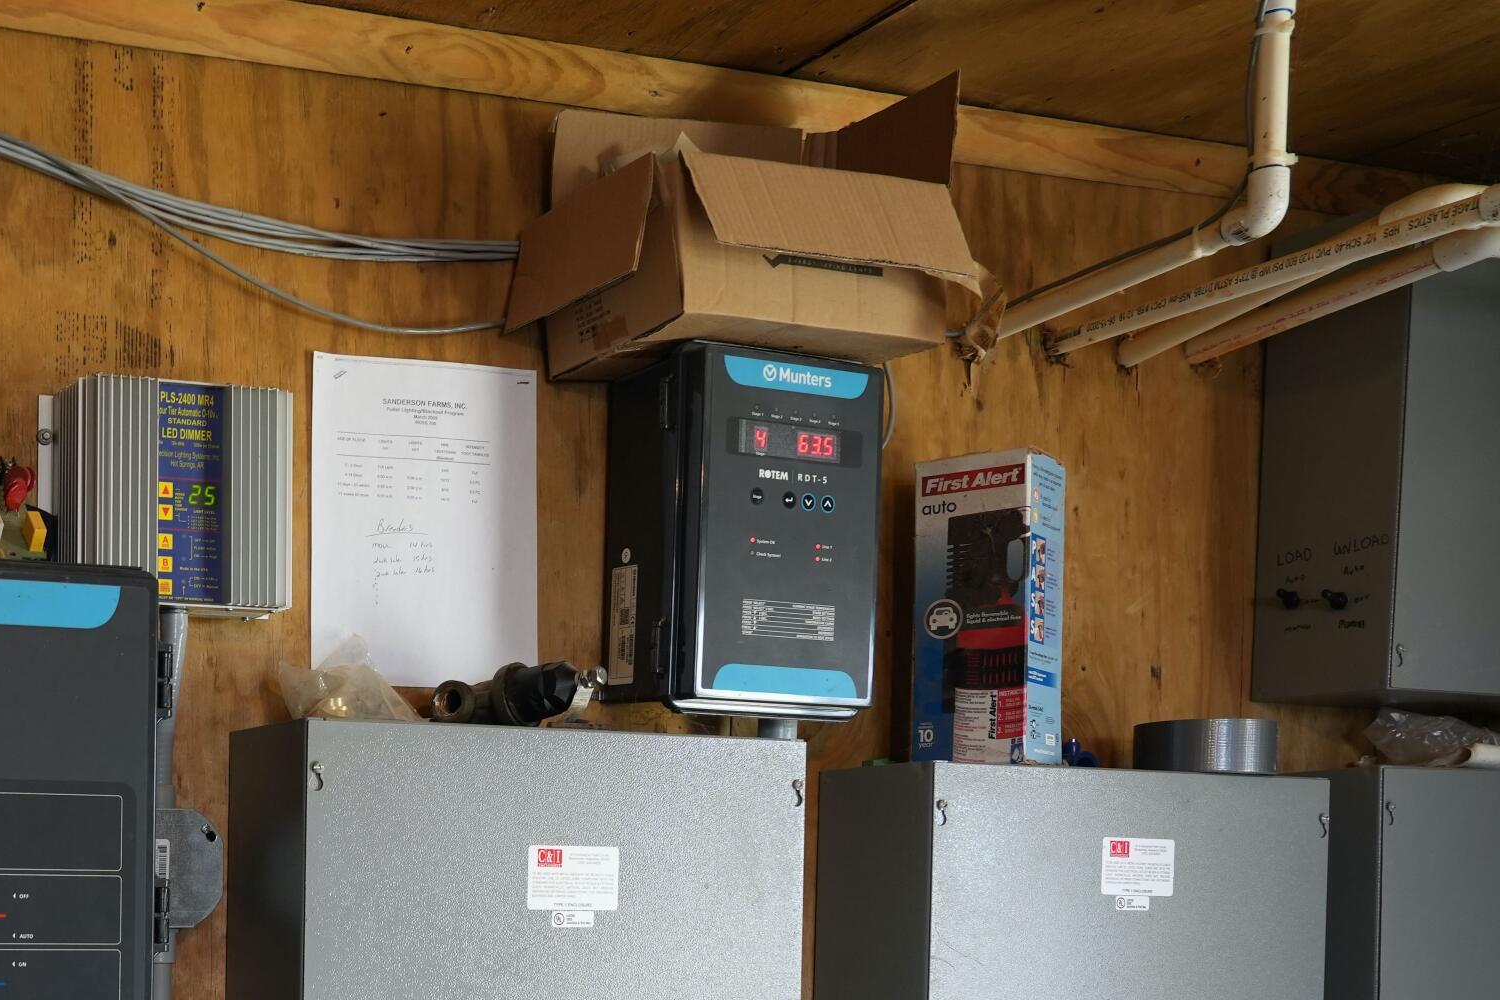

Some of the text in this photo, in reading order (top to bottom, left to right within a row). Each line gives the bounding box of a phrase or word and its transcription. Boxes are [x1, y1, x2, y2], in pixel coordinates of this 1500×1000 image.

[1408, 207, 1451, 231] PLASTICS
[1382, 223, 1400, 239] HPS
[1272, 260, 1285, 273] PSI
[1214, 278, 1233, 290] ASTM
[779, 367, 832, 389] Munters
[160, 391, 214, 406] PLS-2400 MR4
[381, 398, 426, 407] SANDERSON
[454, 402, 468, 410] INC.
[167, 417, 207, 427] STANDARD
[161, 427, 213, 441] LED DIMMER
[755, 427, 768, 449] 4
[759, 468, 789, 481] ROTEM
[925, 466, 1020, 494] First Alert
[188, 484, 216, 506] 25
[922, 501, 957, 516] auto
[162, 536, 169, 544] A
[1333, 533, 1390, 556] UNLOAD
[162, 558, 168, 567] B
[1276, 547, 1313, 567] LOAD
[988, 694, 997, 741] First Alert
[918, 728, 934, 742] 10
[918, 741, 934, 751] year
